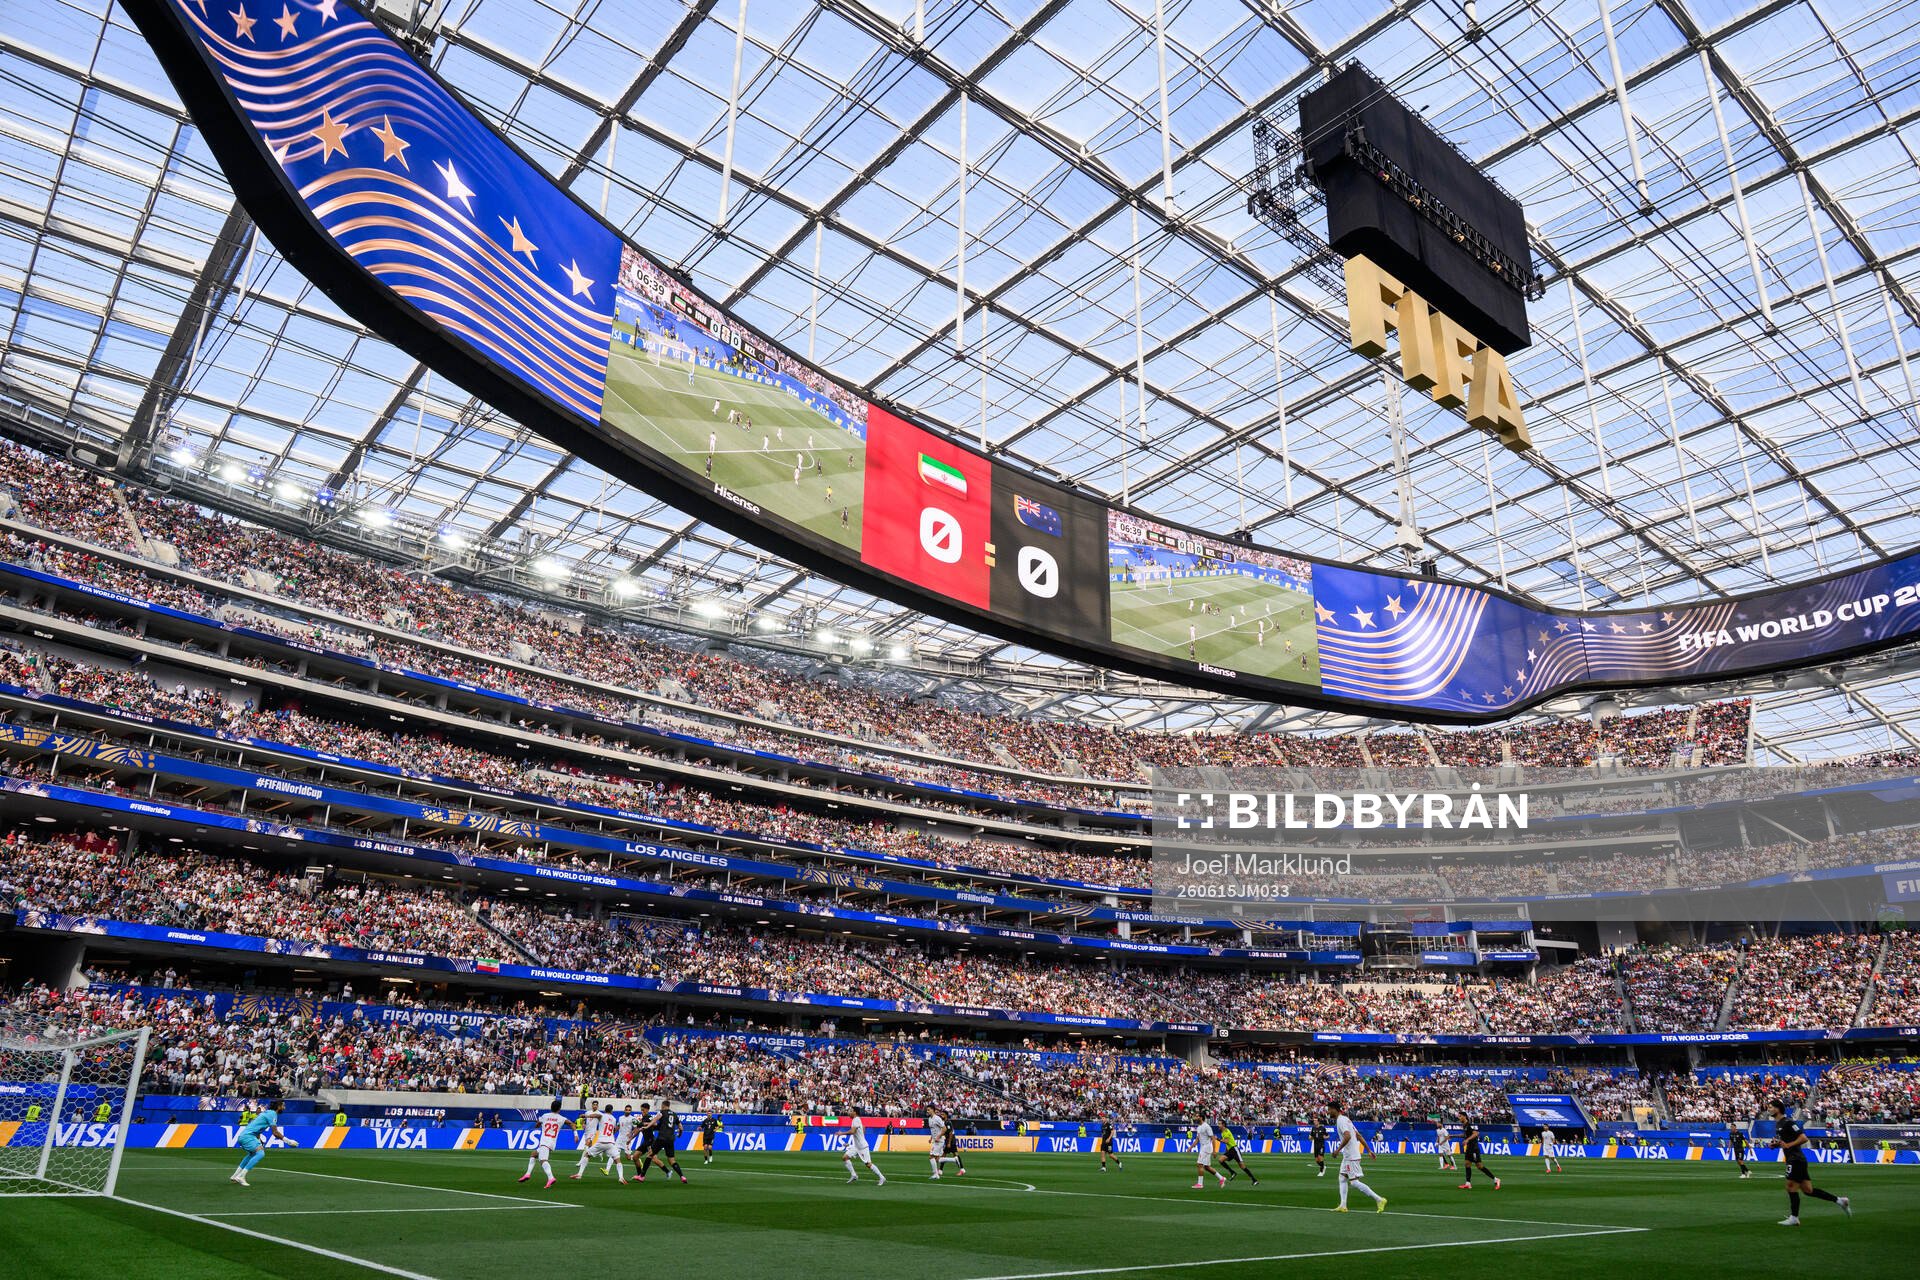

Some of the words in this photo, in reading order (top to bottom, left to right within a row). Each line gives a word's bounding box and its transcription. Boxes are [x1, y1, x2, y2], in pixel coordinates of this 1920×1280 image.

[636, 269, 665, 296] 06:39
[1344, 253, 1533, 453] FIFA
[712, 482, 761, 516] Hisense
[919, 506, 963, 564] 0
[1120, 523, 1142, 537] 06:39
[1017, 545, 1059, 598] 0
[79, 585, 93, 593] FIFA
[93, 588, 115, 599] WORLD
[116, 594, 128, 602] CUP
[128, 597, 150, 608] 2026
[1678, 627, 1736, 651] FIFA
[1735, 609, 1833, 642] WORLD
[1836, 594, 1890, 622] CUP
[1893, 586, 1920, 608] 2
[1198, 662, 1237, 679] Hisense
[106, 708, 120, 716] LOS
[121, 710, 153, 723] ANGELES
[256, 777, 323, 800] #FIFAWorldCup
[354, 839, 372, 850] LOS
[373, 841, 414, 855] ANGELES
[625, 844, 657, 856] LOS
[659, 850, 729, 867] ANGELES
[536, 868, 551, 877] FIFA
[551, 870, 578, 881] WORLD
[578, 874, 593, 883] CUP
[593, 876, 617, 886] 2026
[733, 897, 765, 908] ANGELES
[1114, 912, 1131, 920] FIFA
[1131, 912, 1159, 922] WORLD
[1160, 915, 1175, 923] CUP
[1176, 916, 1204, 925] 2026
[367, 954, 384, 963] LOS
[385, 955, 424, 965] ANGELES
[531, 969, 546, 977] FIFA
[546, 970, 571, 980] WORLD
[572, 974, 586, 982] CUP
[586, 975, 609, 984] 2026
[712, 988, 742, 997] ANGELES
[382, 1009, 410, 1022] FIFA
[411, 1012, 458, 1026] WORLD
[1661, 1034, 1678, 1042] FIFA
[1678, 1034, 1706, 1042] WORLD
[1722, 1033, 1750, 1041] 2026
[1899, 1028, 1917, 1036] LOS
[951, 1048, 968, 1058] FIFA
[384, 1107, 403, 1116] LOS
[404, 1107, 446, 1118] ANGELES
[668, 1115, 674, 1128] 9
[54, 1123, 120, 1147] VISA
[221, 1125, 286, 1149] VA
[544, 1122, 559, 1138] 23
[603, 1122, 614, 1137] 19
[370, 1128, 427, 1149] VISA
[502, 1129, 544, 1150] VIS
[724, 1132, 766, 1151] VISA
[955, 1138, 994, 1149] ANGELES
[1049, 1137, 1079, 1152] VISA
[1114, 1138, 1141, 1152] VISA
[1235, 1139, 1252, 1153] ISA
[1280, 1140, 1302, 1153] VISA
[1371, 1142, 1390, 1154] VISA
[1411, 1142, 1436, 1154] VISA
[1480, 1142, 1511, 1156] VISA
[1553, 1144, 1587, 1158] VISA
[1630, 1146, 1669, 1160] VISA
[1717, 1147, 1759, 1162] VIA
[1809, 1148, 1850, 1163] VISA
